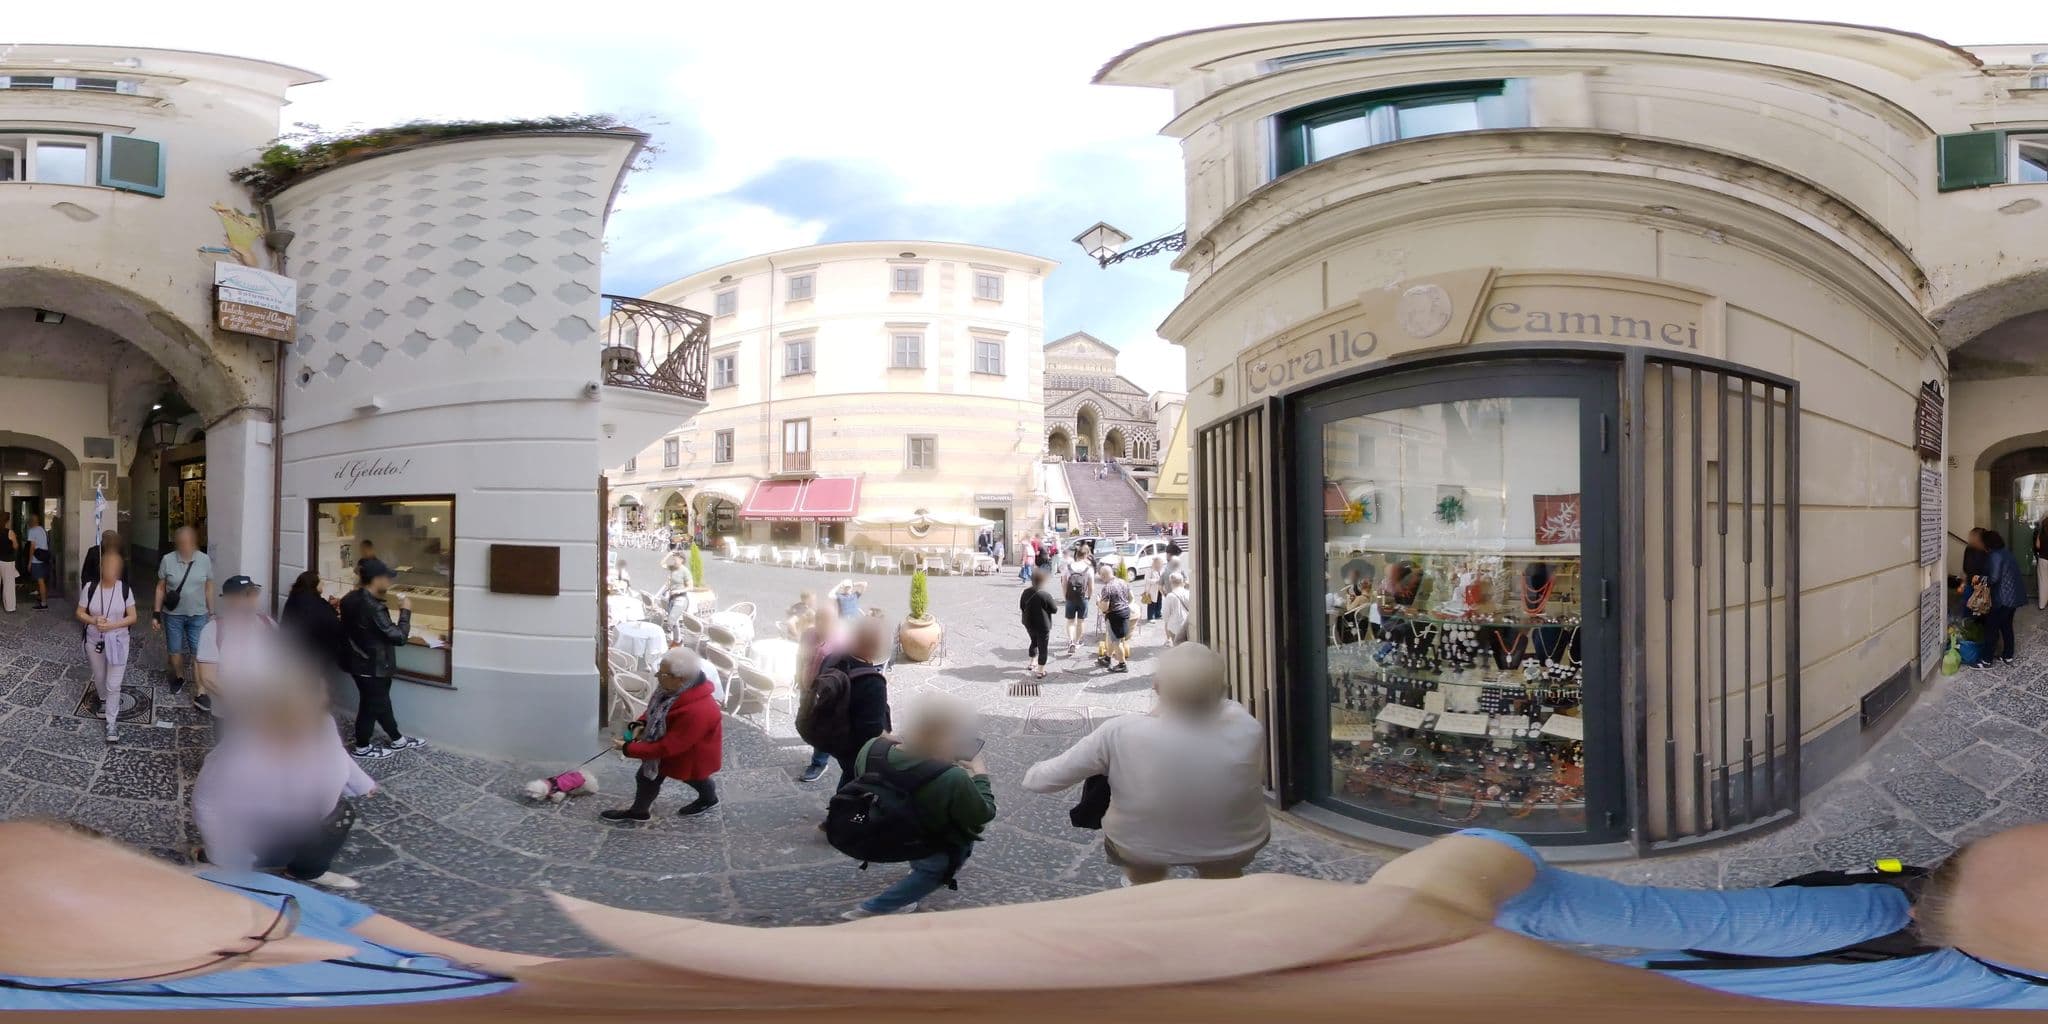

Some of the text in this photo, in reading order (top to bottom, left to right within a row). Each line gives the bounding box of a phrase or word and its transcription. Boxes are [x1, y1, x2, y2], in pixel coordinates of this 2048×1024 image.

[1249, 302, 1698, 394] Corallo Cammei
[334, 457, 411, 491] il Gelato!
